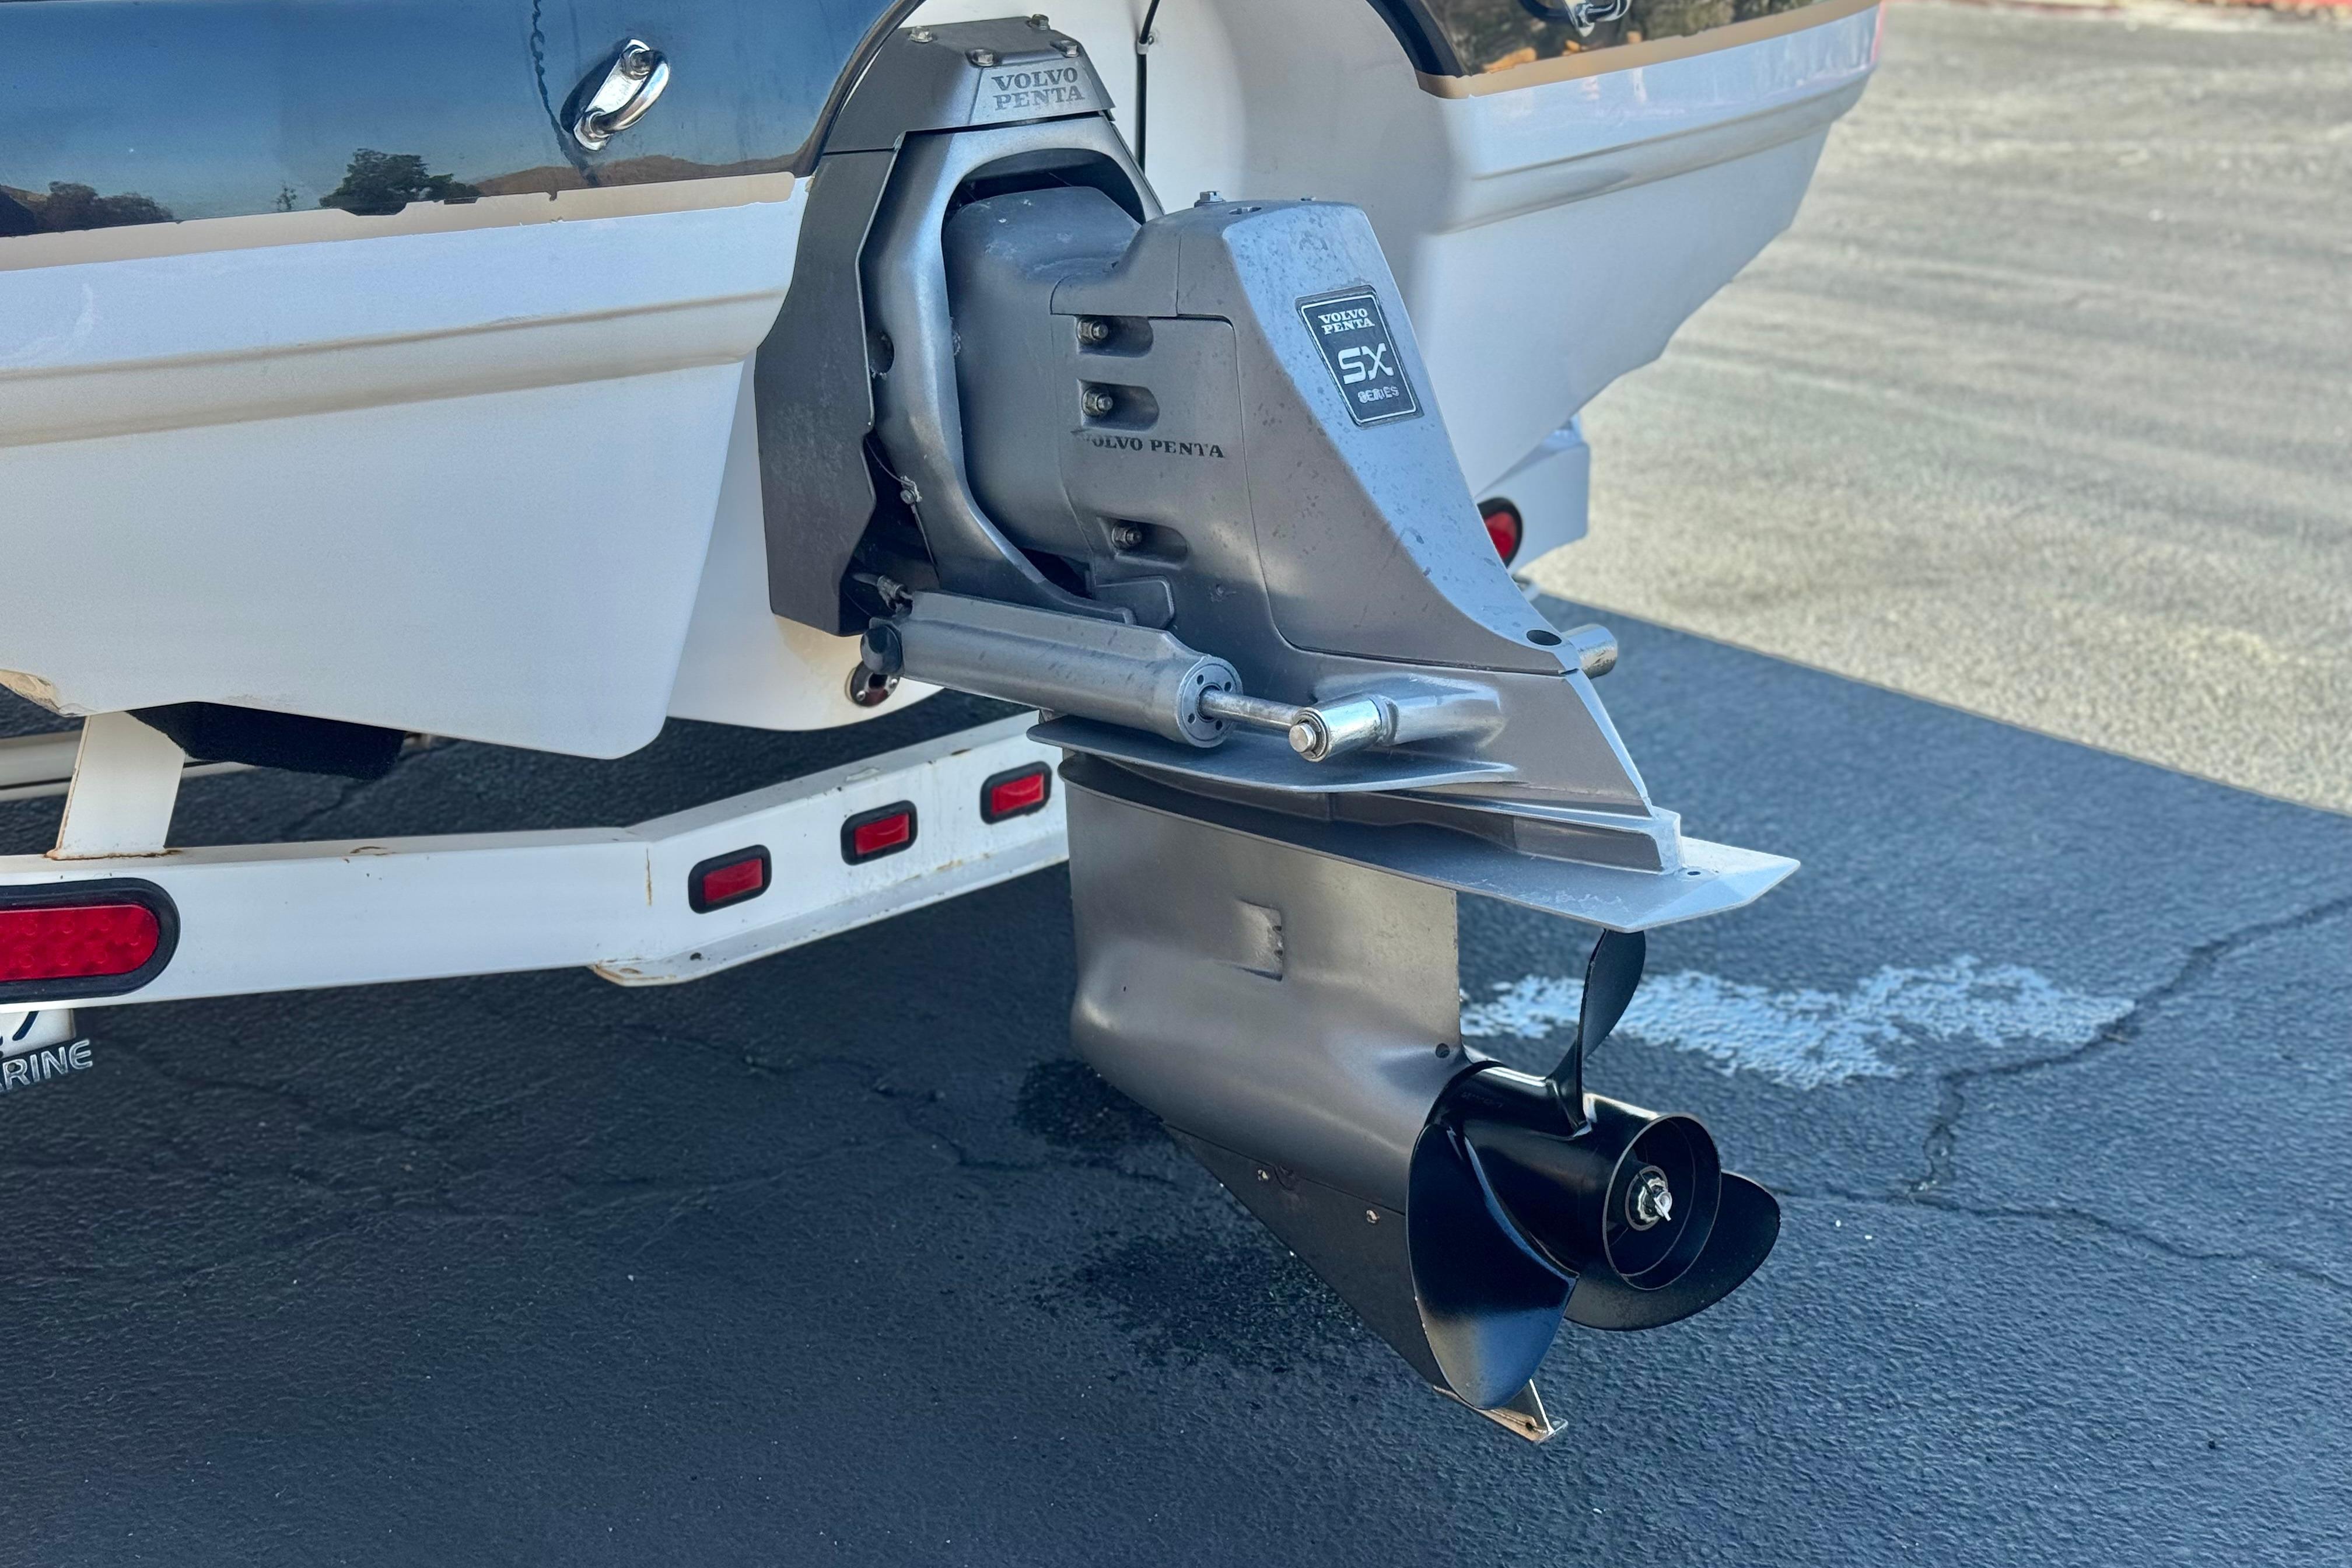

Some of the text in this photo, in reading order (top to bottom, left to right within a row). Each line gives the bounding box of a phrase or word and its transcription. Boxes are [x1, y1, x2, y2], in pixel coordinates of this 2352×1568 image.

[991, 67, 1078, 91] VOLVO
[993, 86, 1085, 110] PENTA
[1318, 308, 1368, 324] VOLVO
[1321, 317, 1375, 335] PENTA
[1338, 342, 1394, 385] SX
[1357, 386, 1399, 403] SERIES
[1082, 435, 1224, 458] OLVO PENTA
[0, 1039, 93, 1093] RINE
